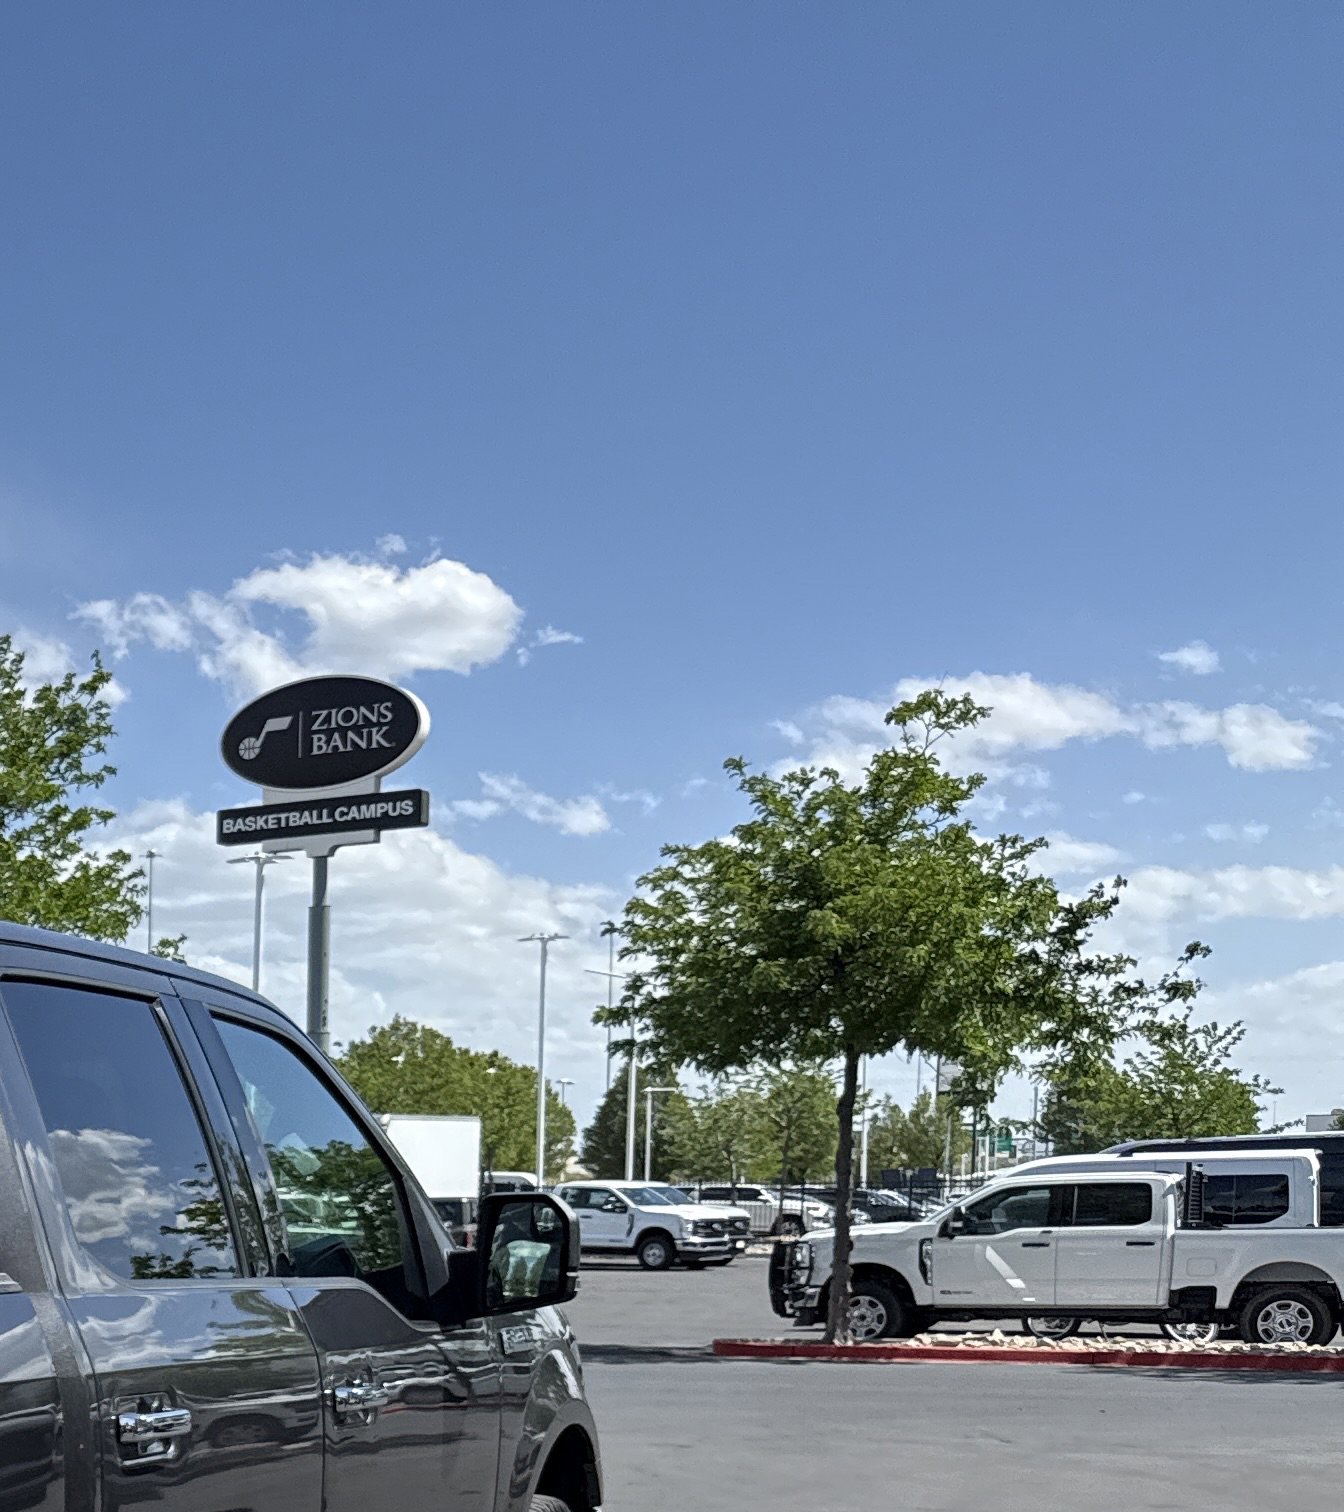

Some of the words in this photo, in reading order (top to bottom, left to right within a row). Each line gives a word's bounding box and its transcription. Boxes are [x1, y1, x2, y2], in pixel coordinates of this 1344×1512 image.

[311, 702, 393, 730] ZIONS
[310, 726, 392, 756] BANK
[222, 808, 333, 834] BASKETBALL
[334, 800, 414, 822] CAMPUS
